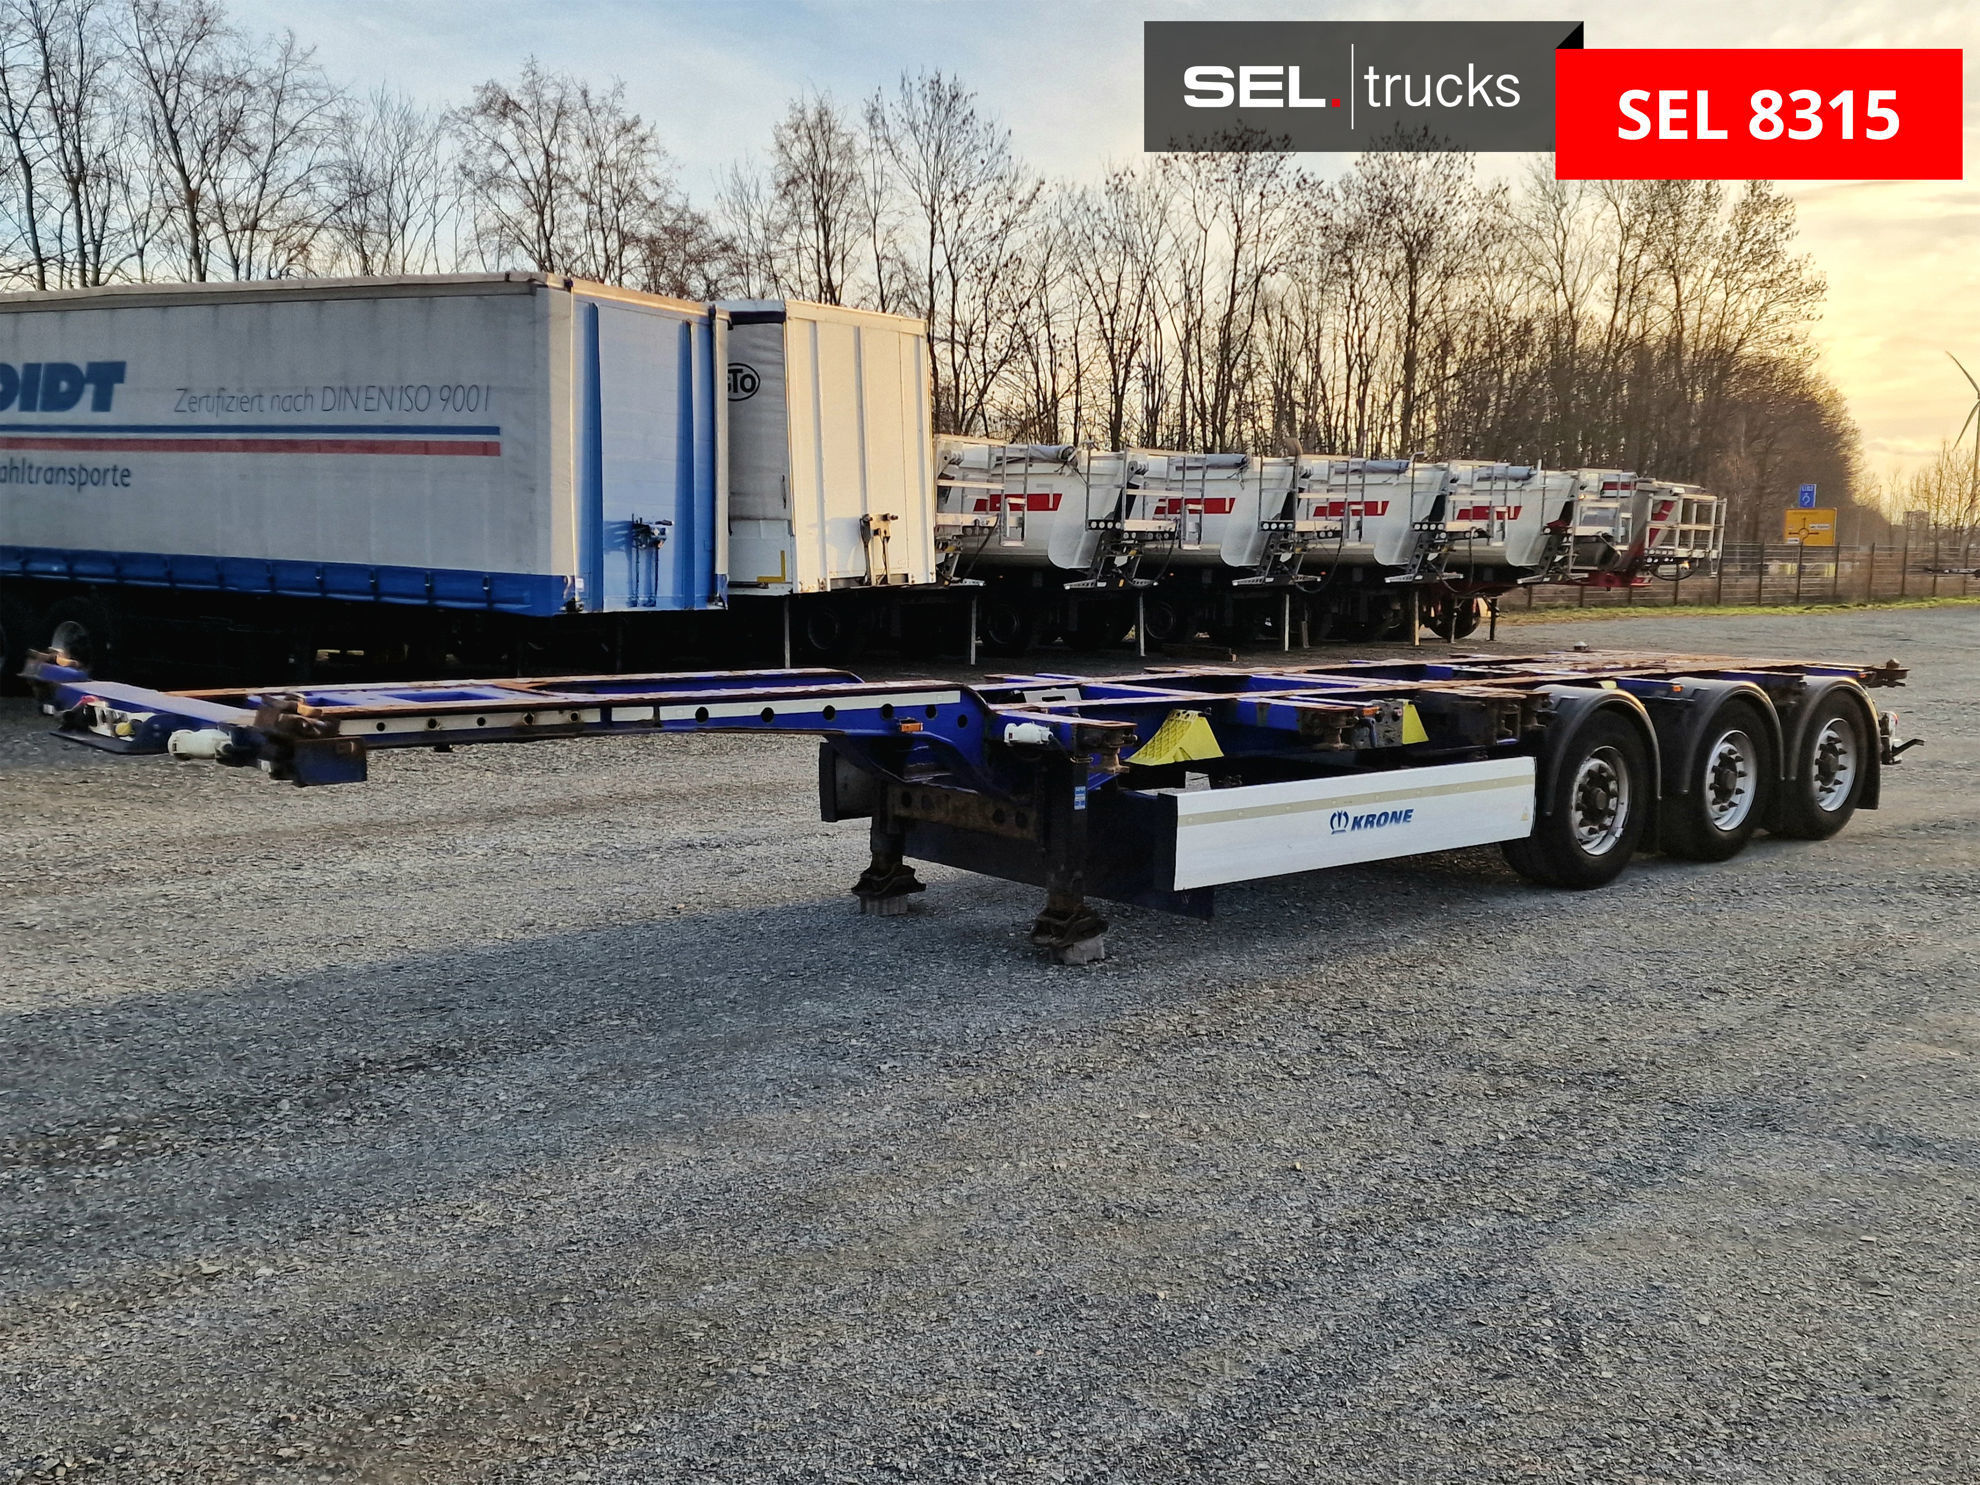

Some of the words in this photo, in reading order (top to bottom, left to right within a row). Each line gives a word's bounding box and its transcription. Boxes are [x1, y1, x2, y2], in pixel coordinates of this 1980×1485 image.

[174, 386, 264, 418] Zertifiziert
[270, 385, 314, 413] nach
[439, 384, 490, 412] 9001
[1350, 808, 1415, 832] KRONE
